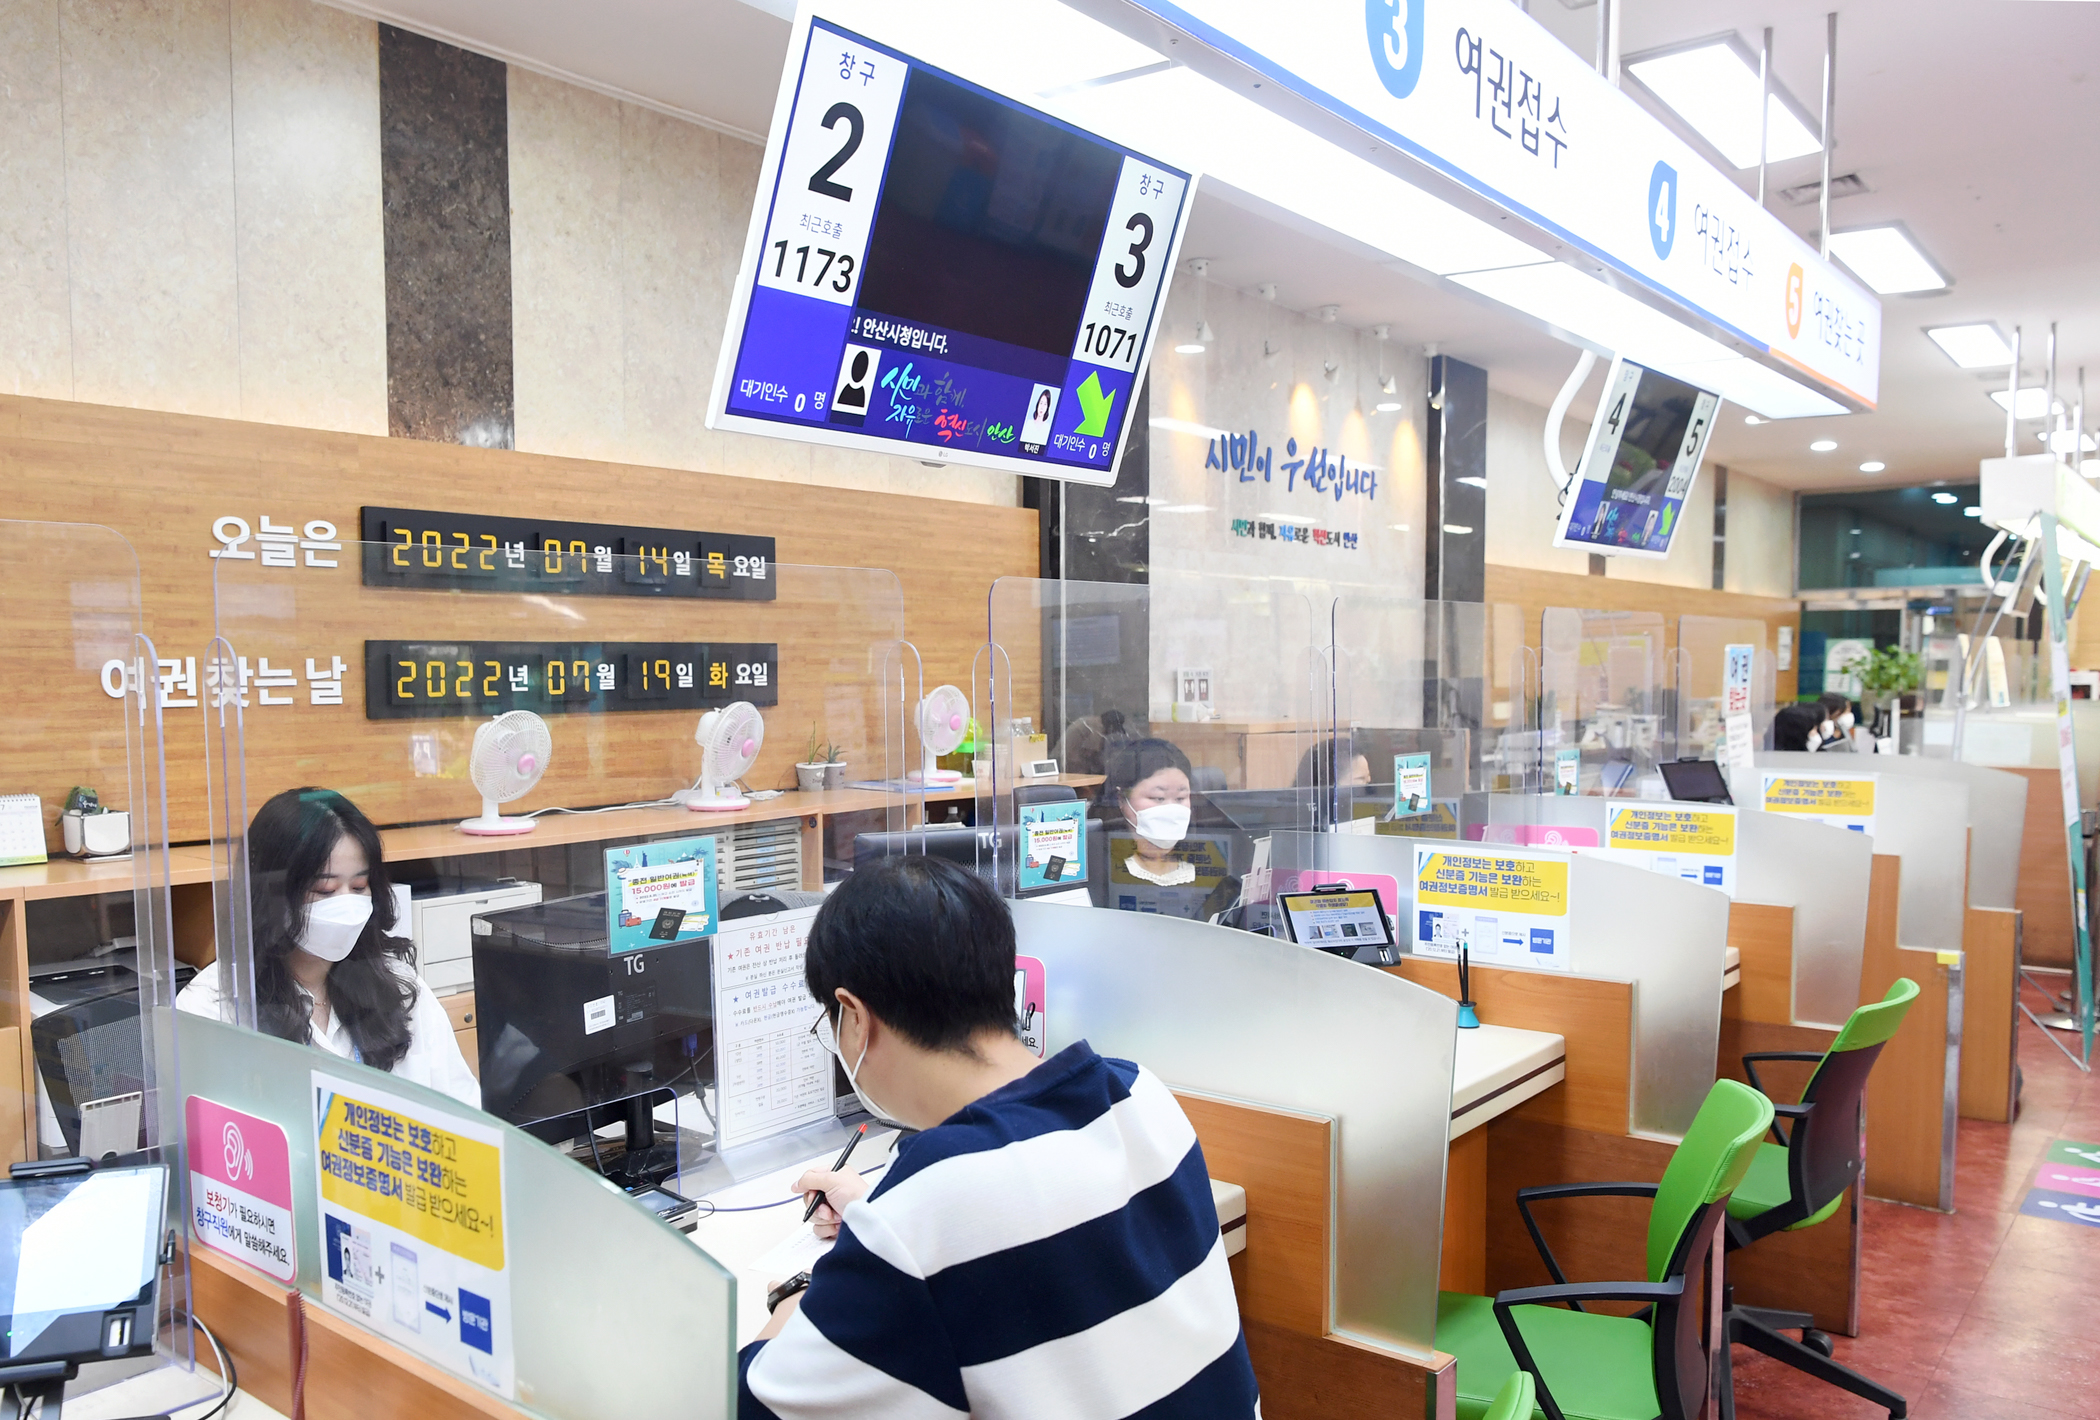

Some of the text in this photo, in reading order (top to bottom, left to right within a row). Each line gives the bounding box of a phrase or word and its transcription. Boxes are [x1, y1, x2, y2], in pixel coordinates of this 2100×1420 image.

[1383, 0, 1568, 170] 3 여권접수
[807, 101, 865, 203] 2
[799, 213, 843, 240] 최근호출
[1655, 180, 1754, 292] 4 여권접수
[773, 239, 855, 293] 1173
[1114, 212, 1154, 289] 3
[1104, 300, 1134, 321] 최근호출
[1788, 275, 1800, 326] 5
[862, 318, 949, 355] 안산시청입니다.
[1083, 322, 1138, 363] 1071
[740, 379, 826, 413] 대기인수 0 명
[1608, 392, 1627, 435] 4
[1053, 433, 1112, 460] 대기인수 0 명
[1686, 418, 1704, 457] 5
[1205, 429, 1378, 502] 시민이 우선입니다
[208, 515, 342, 568] 오늘은
[1625, 821, 1649, 830] 신분증
[1630, 810, 1672, 821] 개인정보는
[978, 832, 1003, 849] TG
[1611, 830, 1669, 841] 여권정보증명서
[1436, 869, 1541, 888] 신분증 기능은 보완하는
[1442, 855, 1535, 873] 개인정보는 보호하고
[679, 878, 696, 888] 발급
[1419, 880, 1488, 897] 여권정보증명서
[1490, 887, 1508, 899] 발급
[735, 947, 751, 958] 기존
[754, 943, 770, 954] 여권
[775, 940, 791, 951] 반납
[749, 924, 796, 941] 유효기간 남은
[623, 953, 645, 976] TG
[745, 985, 777, 1000] 여권발급
[344, 1101, 457, 1162] 개인정보는 보호하고
[321, 1150, 404, 1202] 여권정보증명서
[405, 1182, 427, 1212] 발급
[338, 1128, 467, 1198] 신분증 기능은 보완하는
[206, 1189, 276, 1235] 보청기가 필요하시면
[196, 1206, 290, 1266] 창구직원에게 말씀해주세요.
